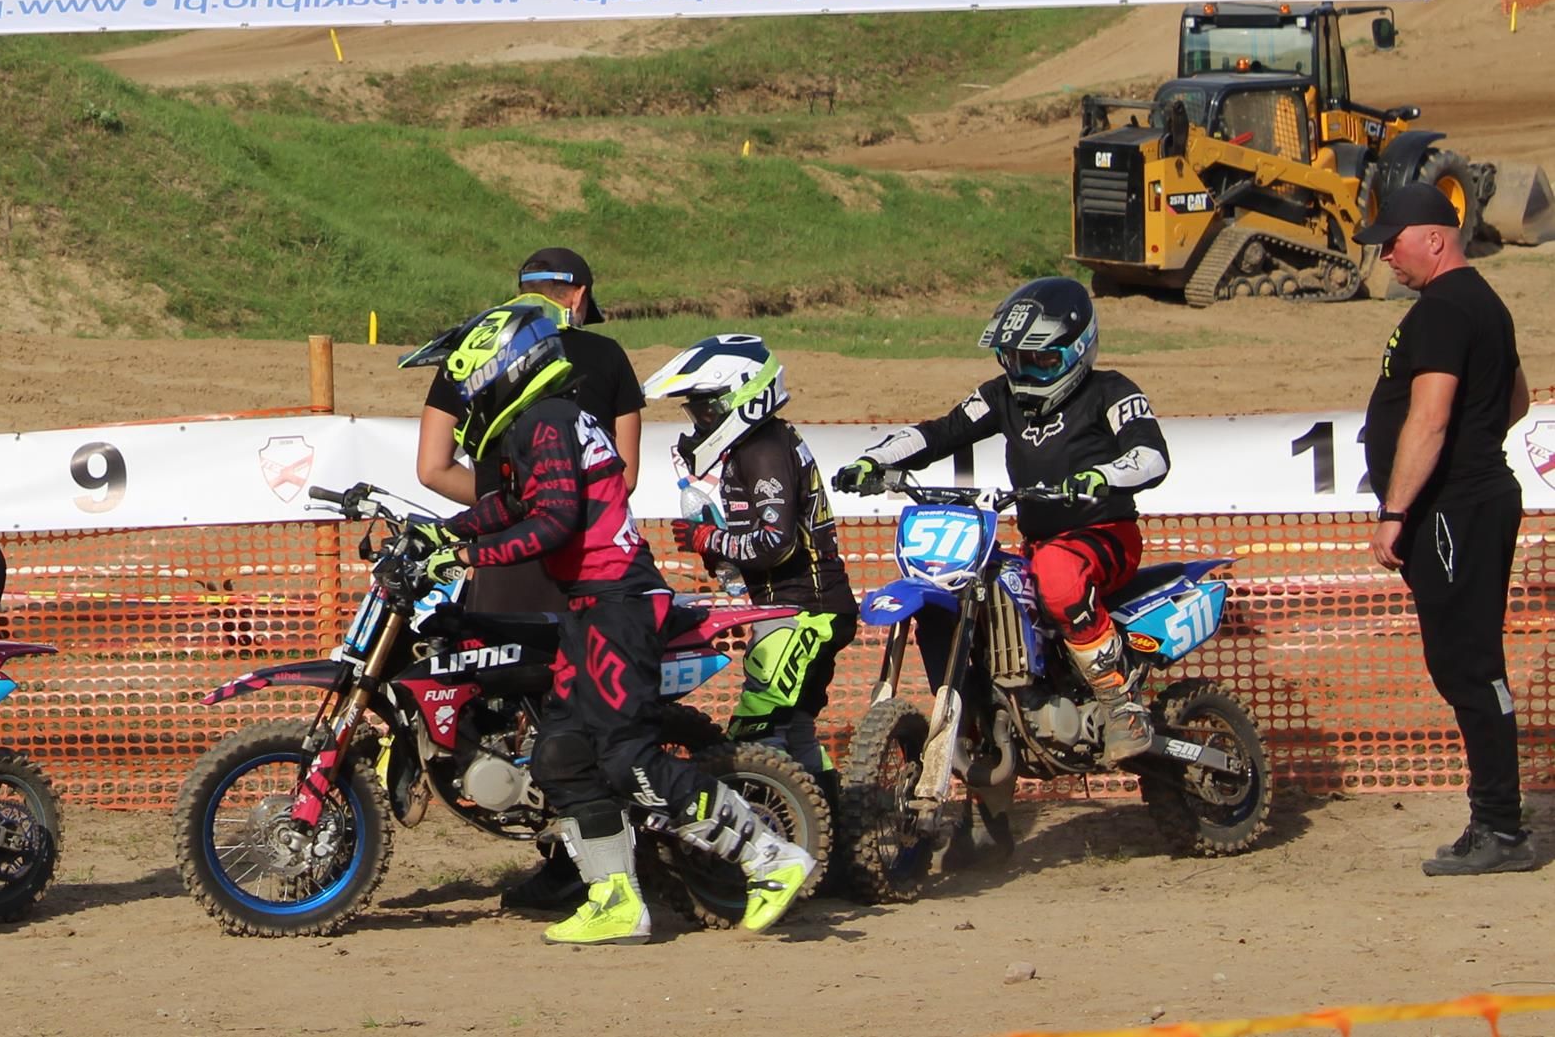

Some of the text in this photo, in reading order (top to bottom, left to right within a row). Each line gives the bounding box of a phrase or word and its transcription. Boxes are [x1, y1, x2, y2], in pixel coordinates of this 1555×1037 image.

[1095, 151, 1112, 168] CAT
[1187, 193, 1208, 211] CAT
[70, 442, 128, 513] 9
[900, 518, 980, 561] 511
[1164, 594, 1215, 657] 511
[430, 643, 522, 676] LIPNO
[777, 627, 819, 698] UFO
[424, 688, 459, 702] FUNT
